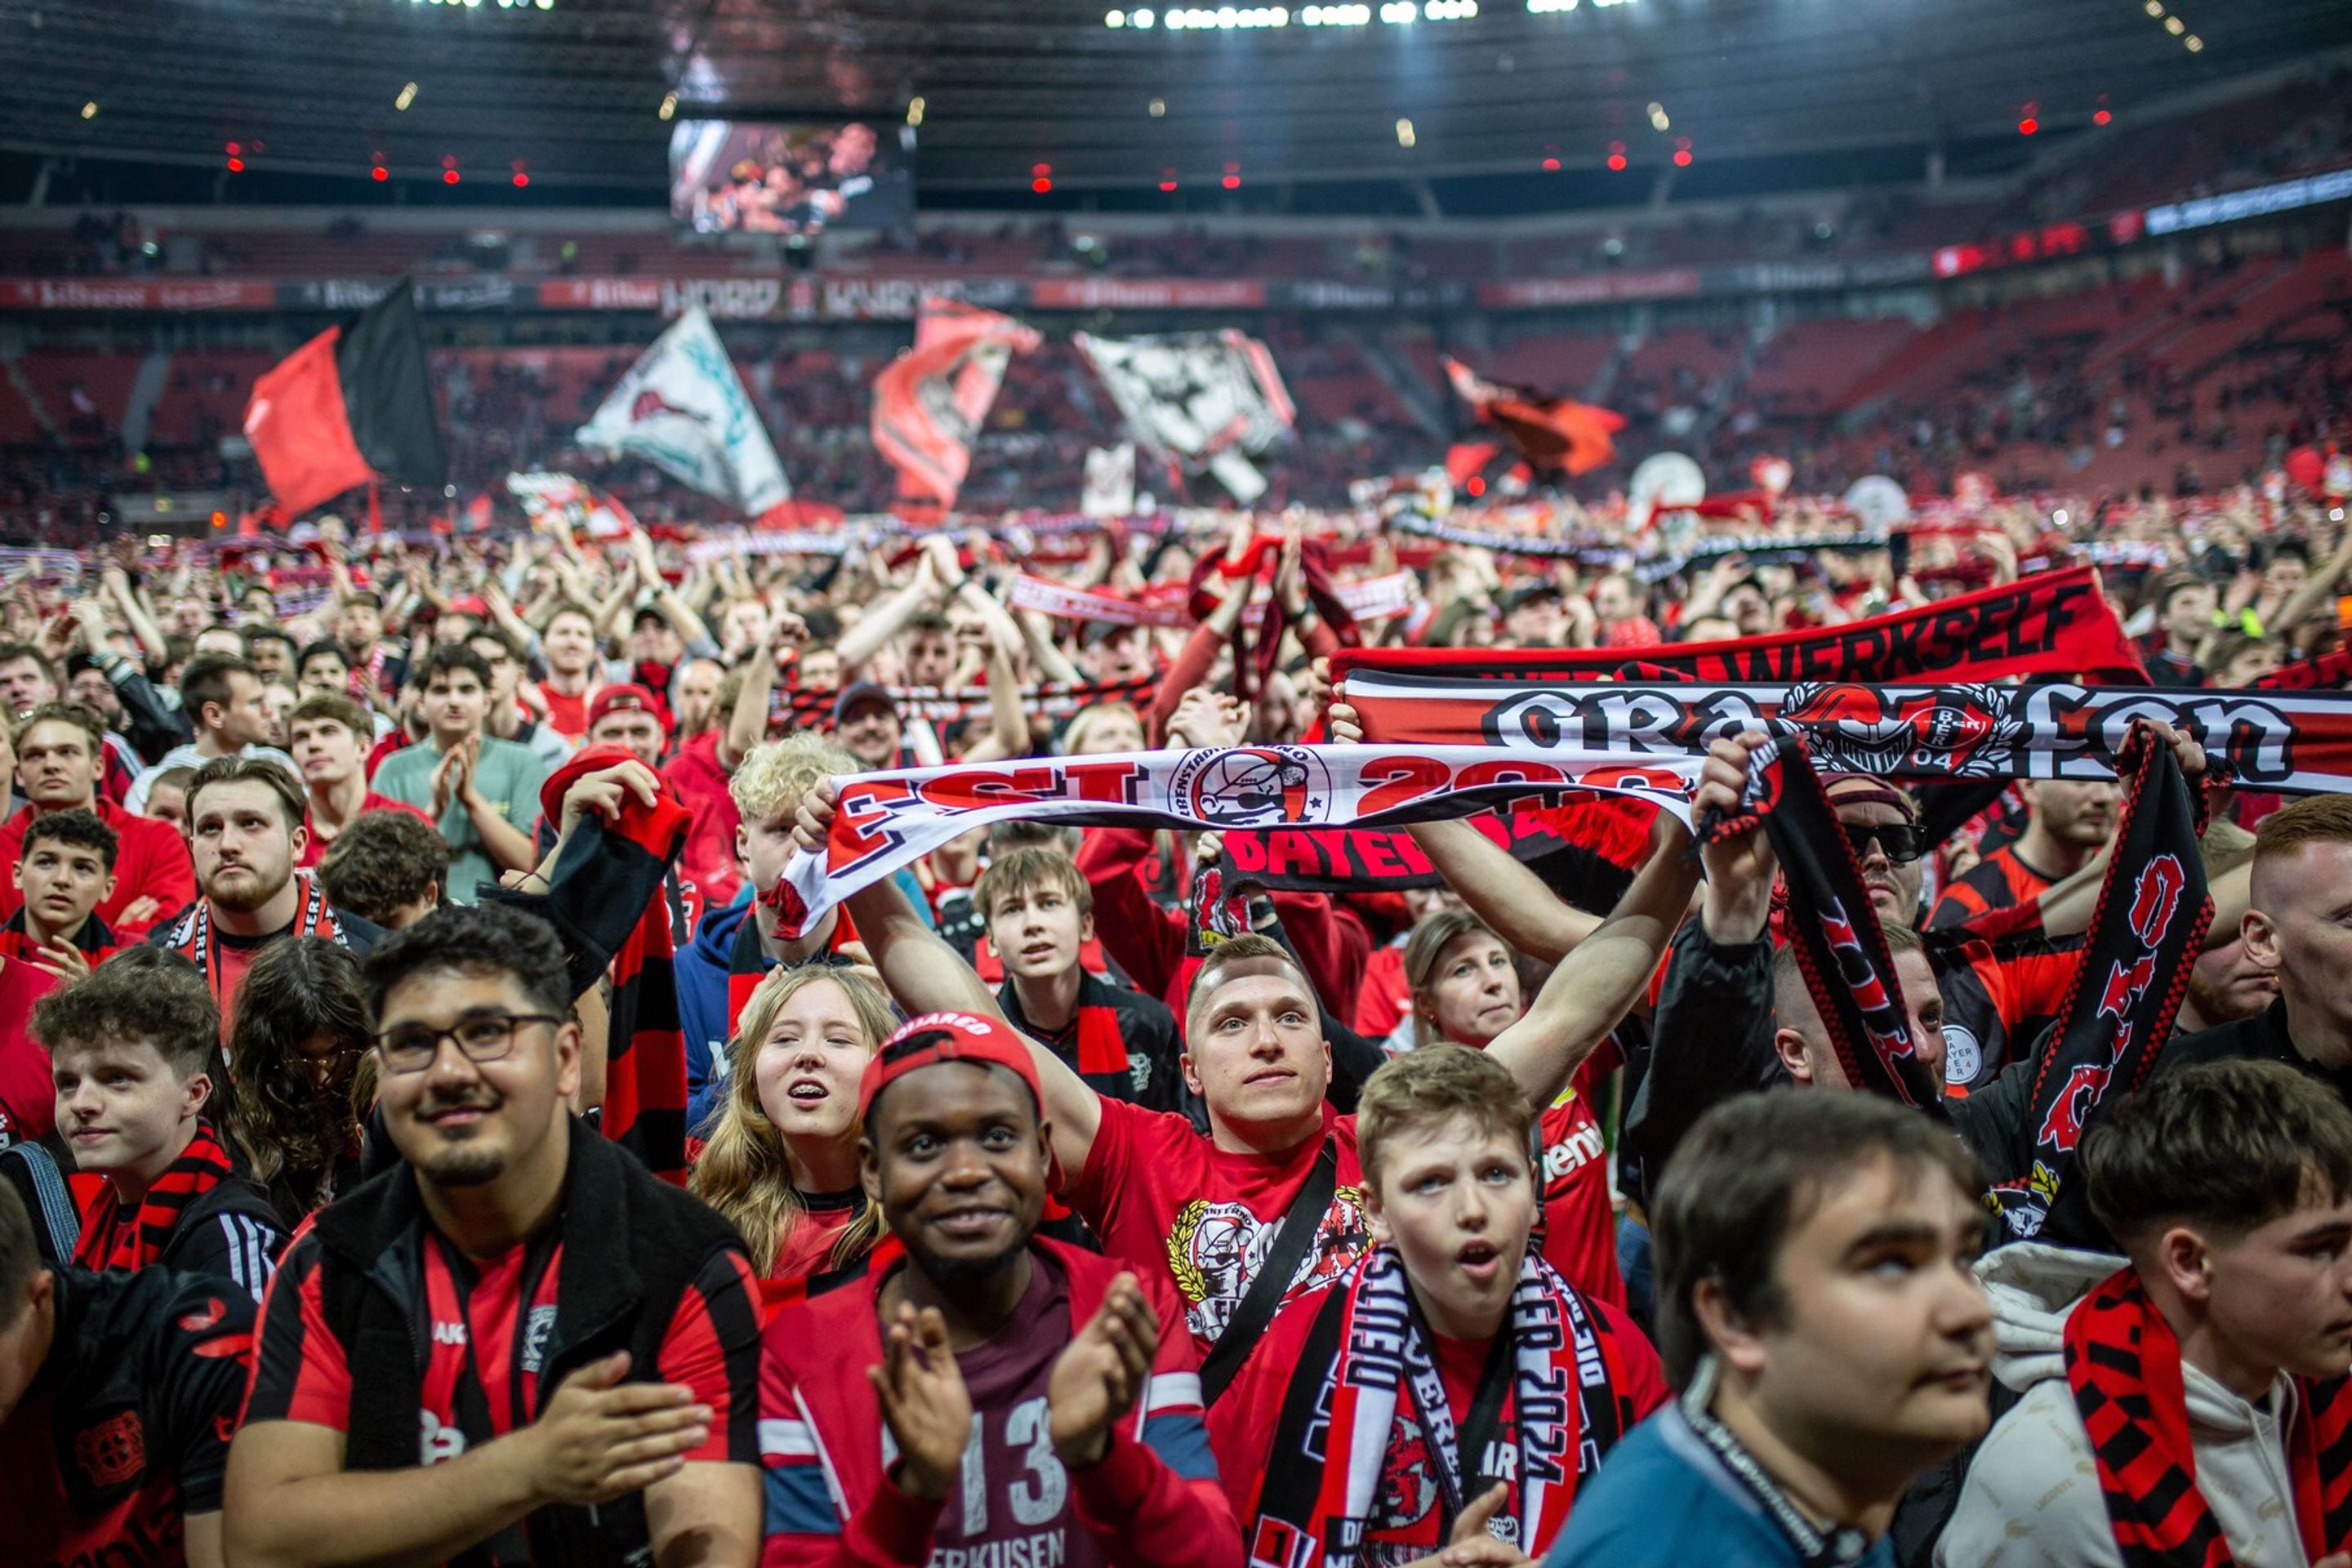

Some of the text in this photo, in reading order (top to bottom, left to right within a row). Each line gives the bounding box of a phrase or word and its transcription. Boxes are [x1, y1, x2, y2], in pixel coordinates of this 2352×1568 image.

[1718, 583, 2093, 683] WERKSELF
[1913, 749, 1952, 769] 04
[1205, 1206, 1253, 1226] INFERNO
[1518, 1365, 1567, 1486] 2024
[962, 1396, 1067, 1538] 13
[927, 1527, 1066, 1568] ERKUSEN
